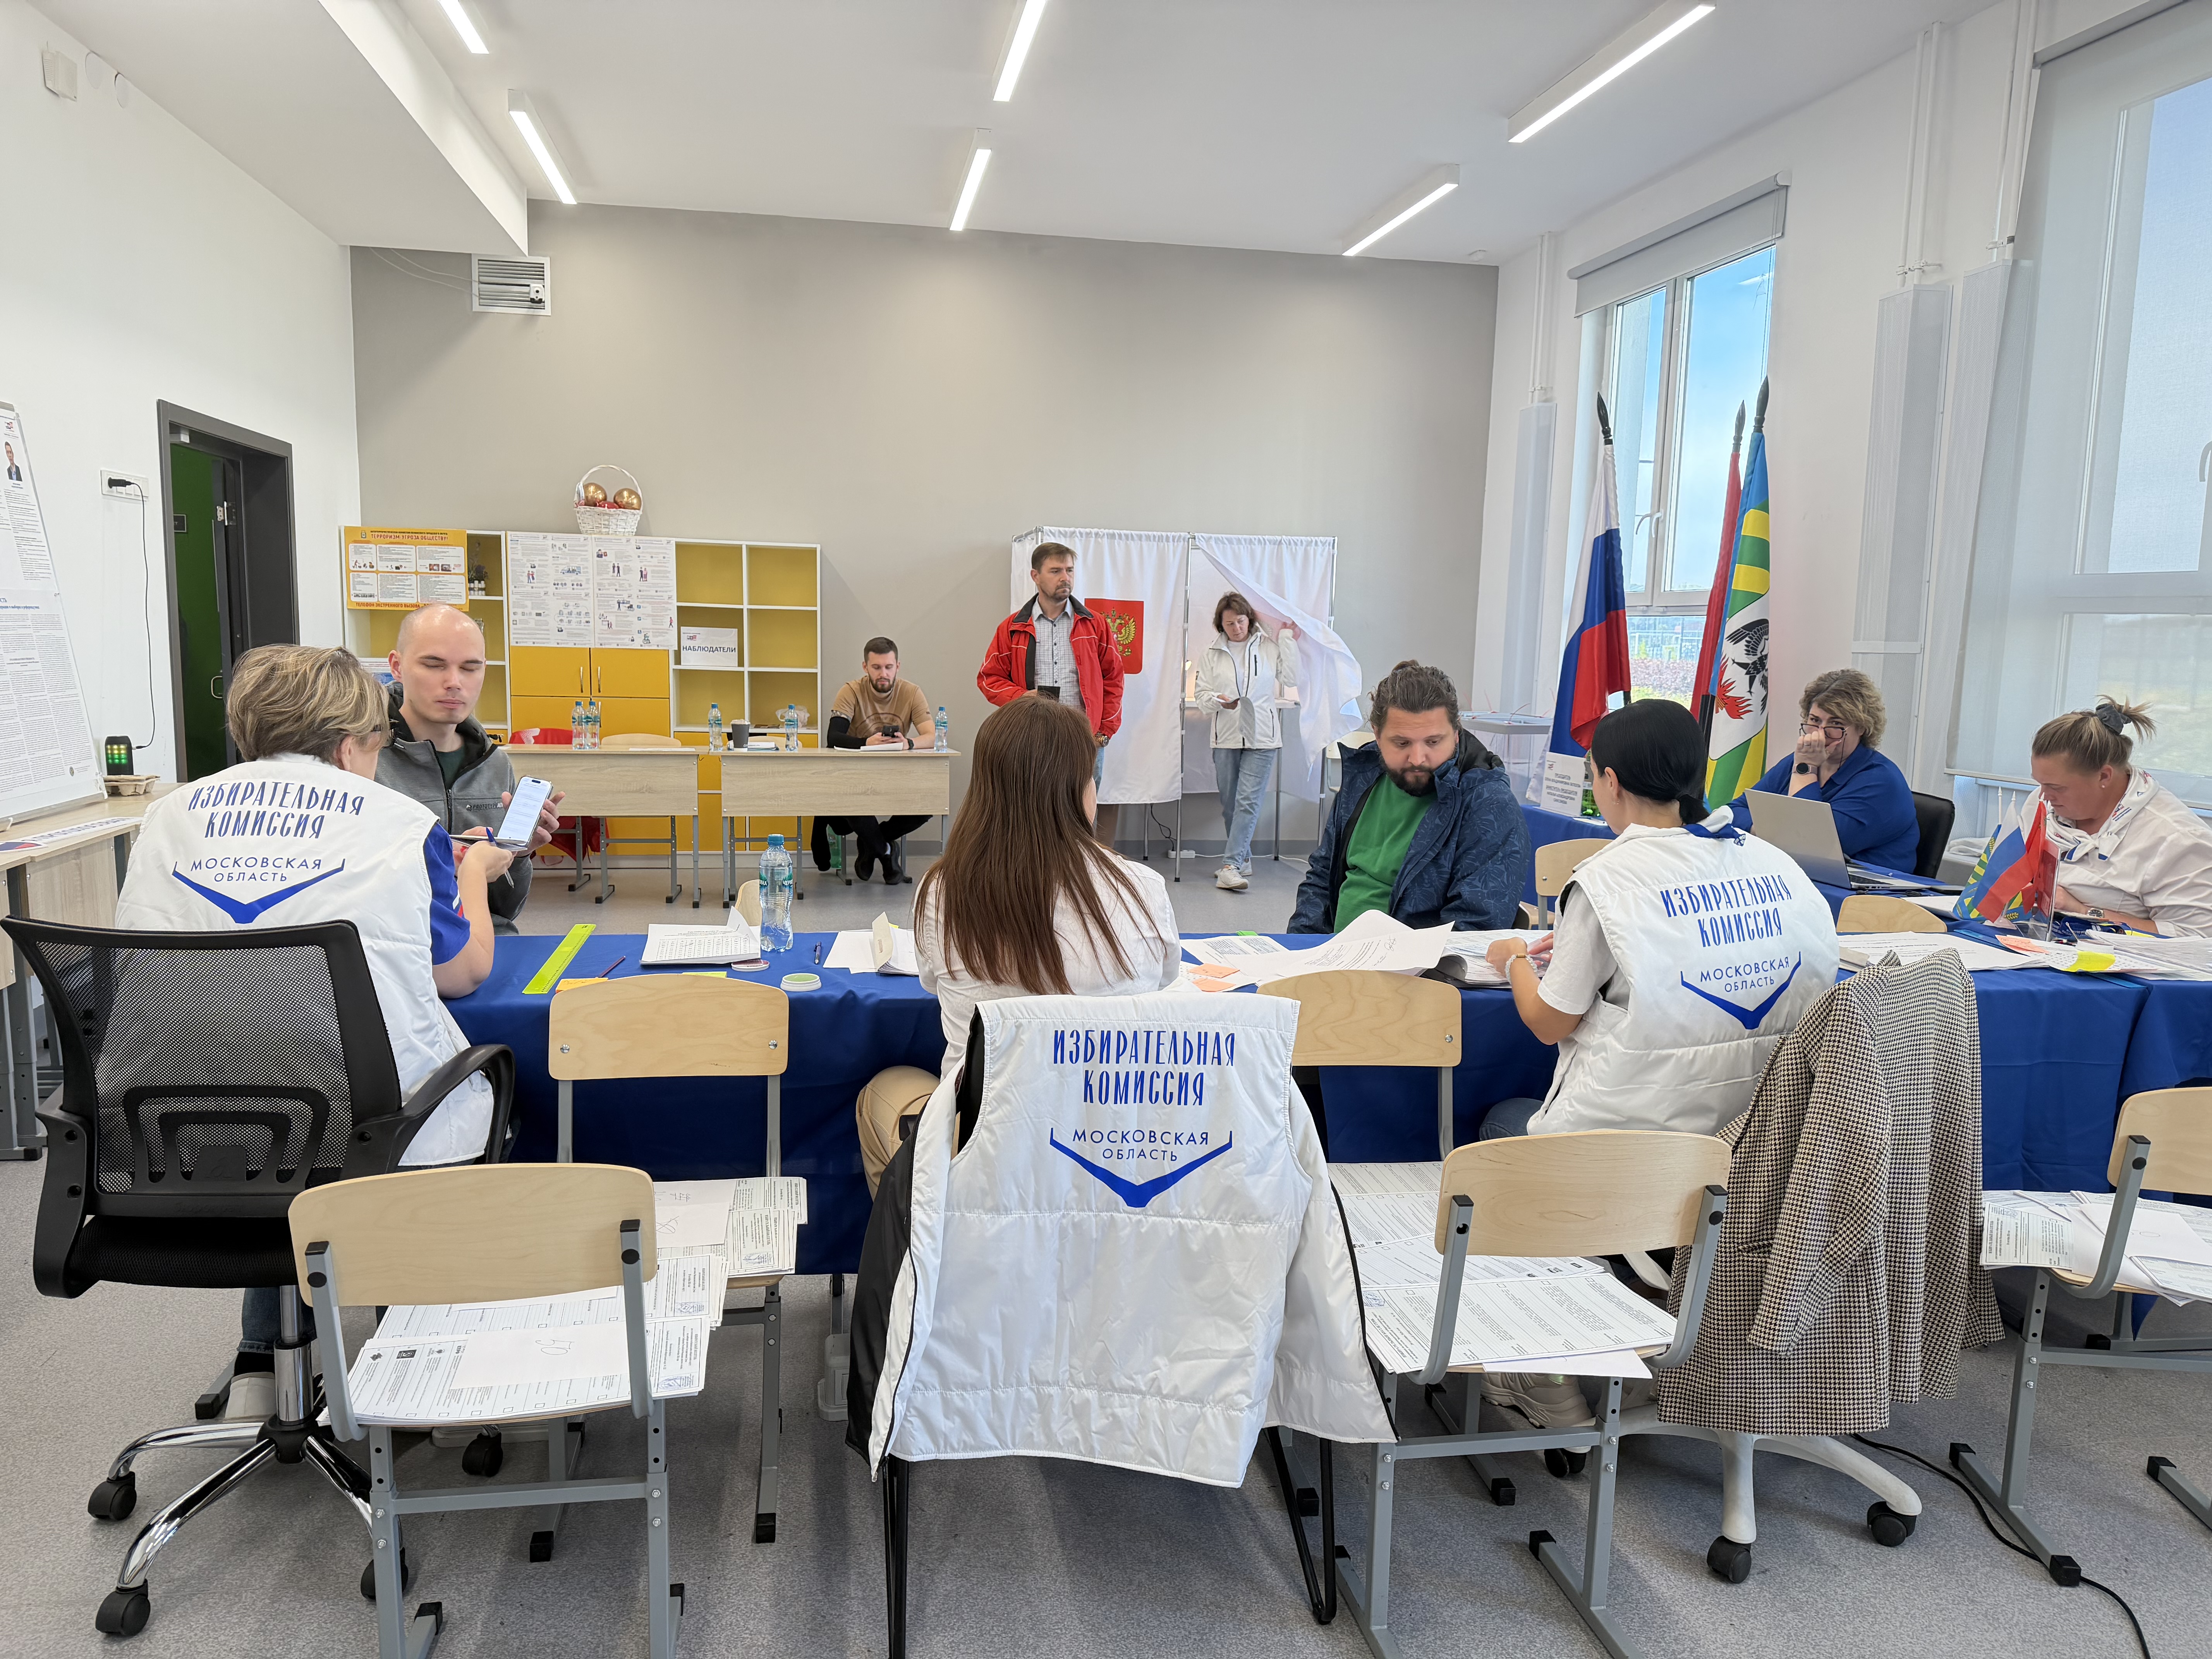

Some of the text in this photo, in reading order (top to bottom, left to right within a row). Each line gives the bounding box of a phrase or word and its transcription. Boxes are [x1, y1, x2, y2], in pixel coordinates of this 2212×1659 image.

[188, 781, 364, 816] ИЗБИРАТЕЛЬНАЯ
[204, 811, 325, 839] КОМИССИЯ
[191, 857, 322, 872] МОСКОВСКАЯ
[214, 872, 287, 882] ОБЛАСТЬ
[1660, 874, 1792, 917] ИЗБИРАТЕЛЬНАЯ
[1698, 908, 1782, 947] КОМИССИЯ
[1700, 957, 1789, 982] МОСКОВСКАЯ
[1725, 976, 1774, 992] ОБЛАСТЬ
[1053, 1030, 1235, 1066] ИЗБИРАТЕЛЬНАЯ
[1084, 1070, 1204, 1106] КОМИССИЯ
[1073, 1129, 1208, 1145] МОСКОВСКАЯ
[1103, 1149, 1177, 1161] ОБЛАСТЬ
